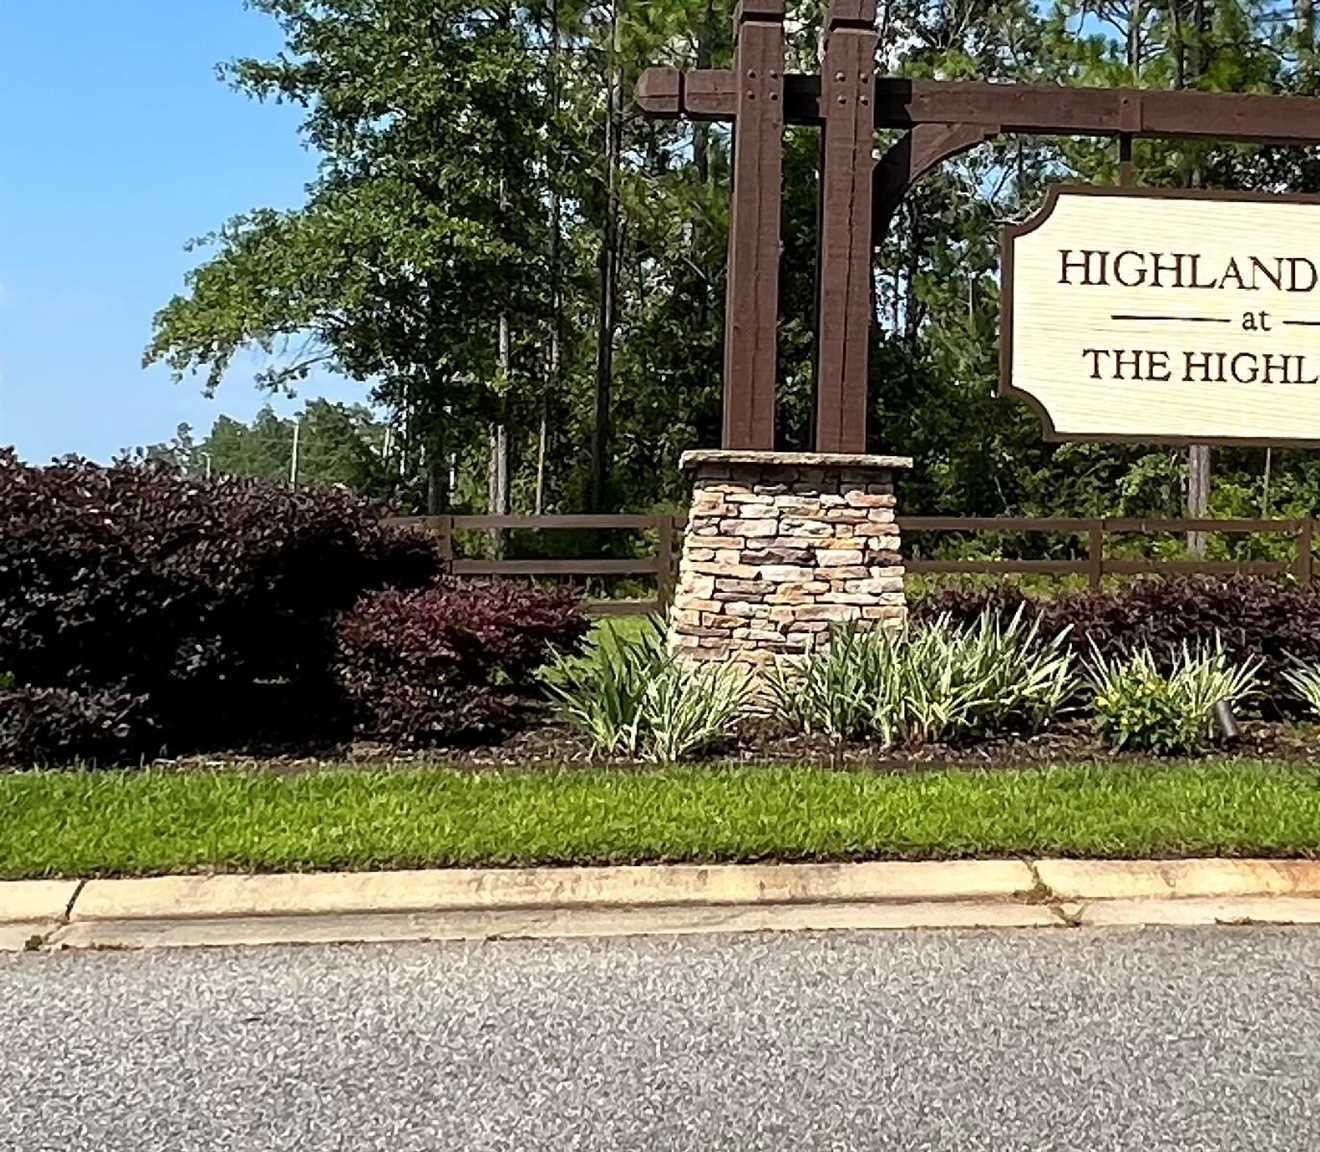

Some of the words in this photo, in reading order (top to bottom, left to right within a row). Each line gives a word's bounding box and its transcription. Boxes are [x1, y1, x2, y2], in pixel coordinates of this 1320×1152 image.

[1058, 250, 1317, 292] HIGHLAND
[1242, 311, 1271, 331] at
[1083, 349, 1171, 381] THE
